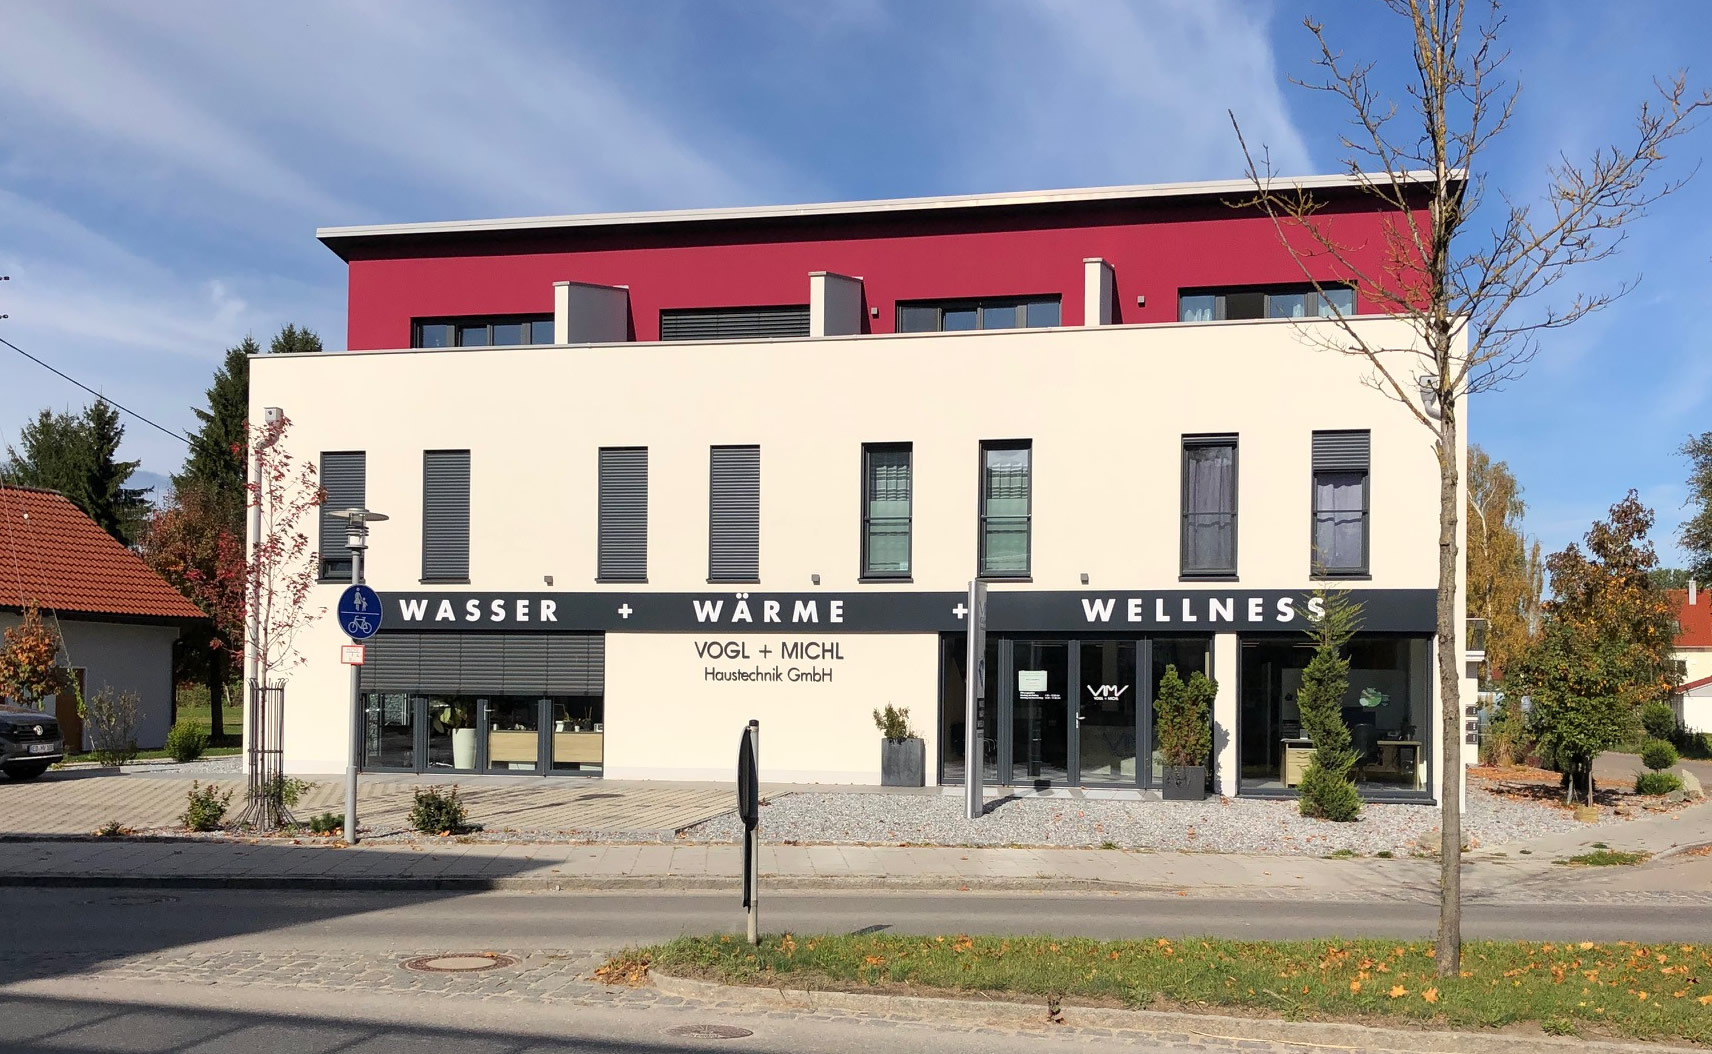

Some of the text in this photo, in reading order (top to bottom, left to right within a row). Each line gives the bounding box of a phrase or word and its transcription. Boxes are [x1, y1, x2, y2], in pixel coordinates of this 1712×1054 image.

[398, 598, 558, 622] WASSER
[617, 603, 633, 619] +
[692, 593, 844, 623] WÄRME
[1081, 597, 1326, 623] WELLNESS
[694, 640, 845, 661] VOGL + MICHL
[704, 665, 833, 682] Haustechnik GmbH
